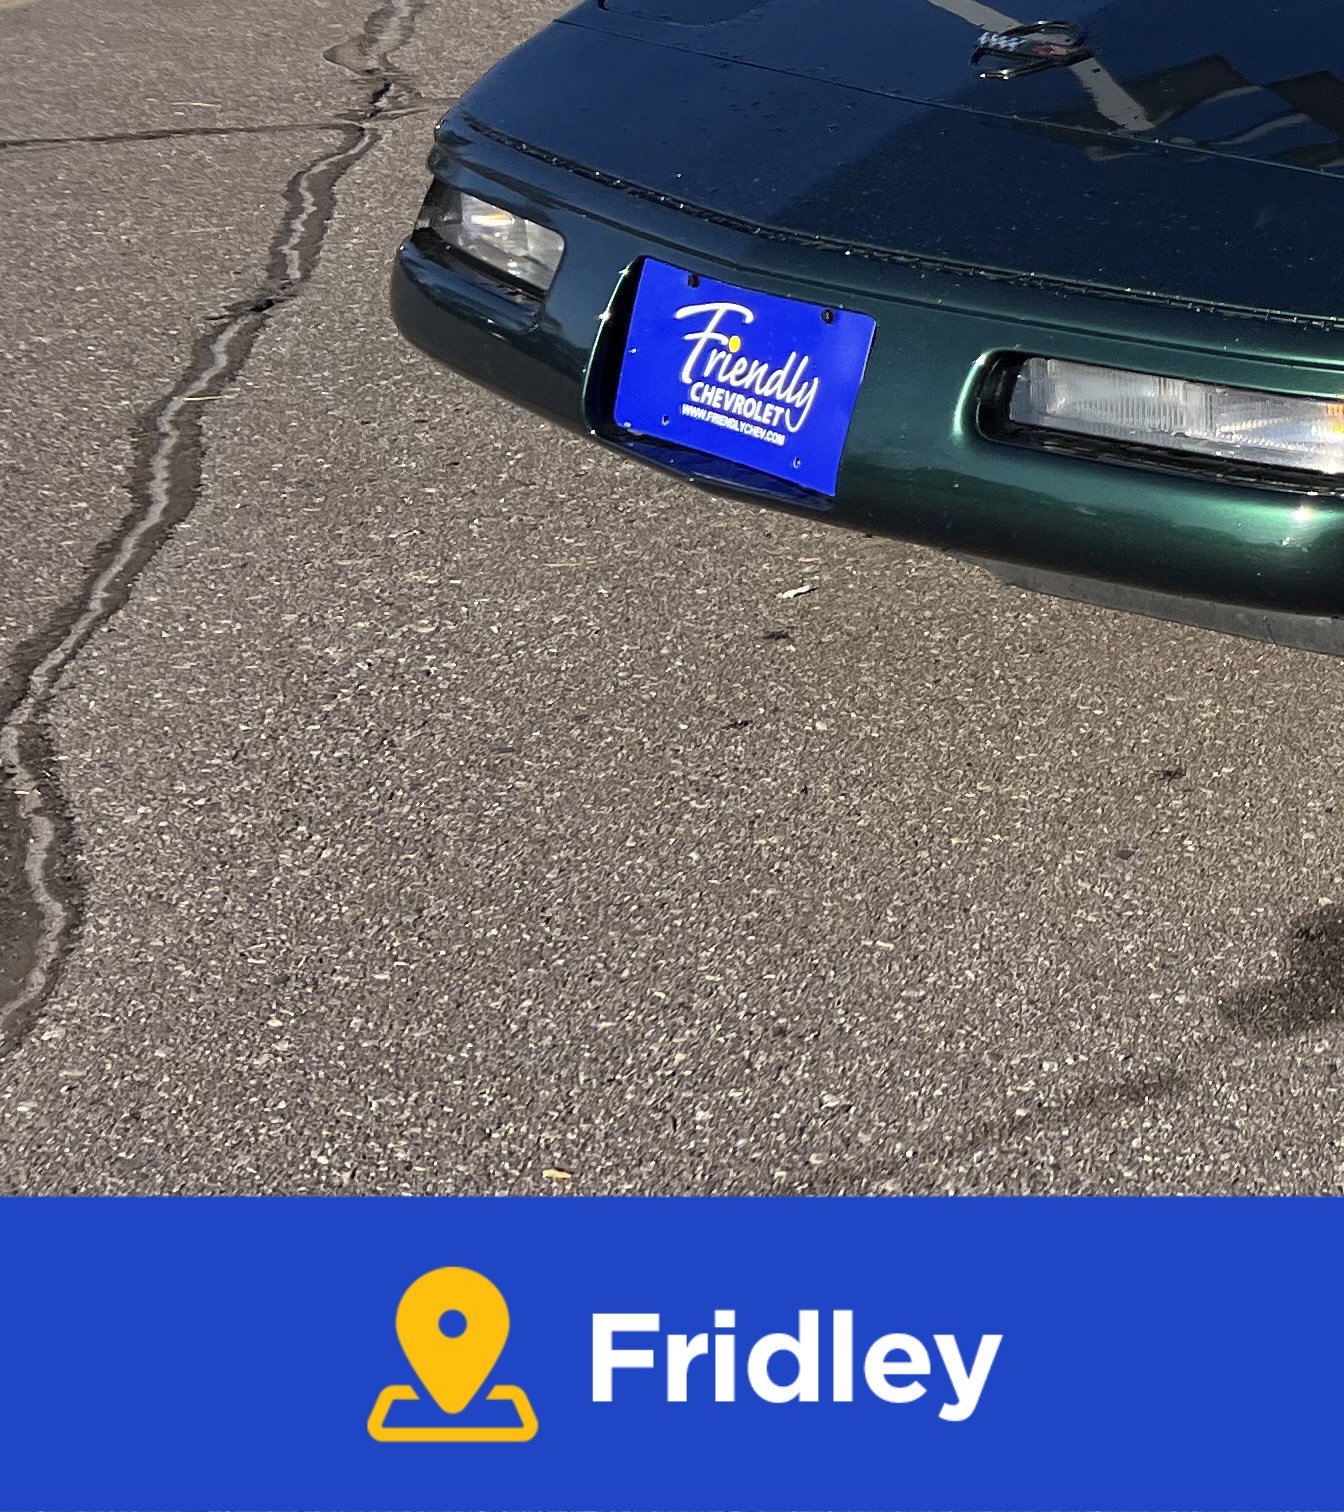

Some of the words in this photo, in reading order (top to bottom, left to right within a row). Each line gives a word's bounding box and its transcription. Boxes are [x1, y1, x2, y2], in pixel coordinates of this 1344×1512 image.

[674, 301, 819, 433] Friendly
[681, 403, 786, 447] WWW.FRIENDLYCHEV.COM
[690, 381, 785, 427] CHEVROLET
